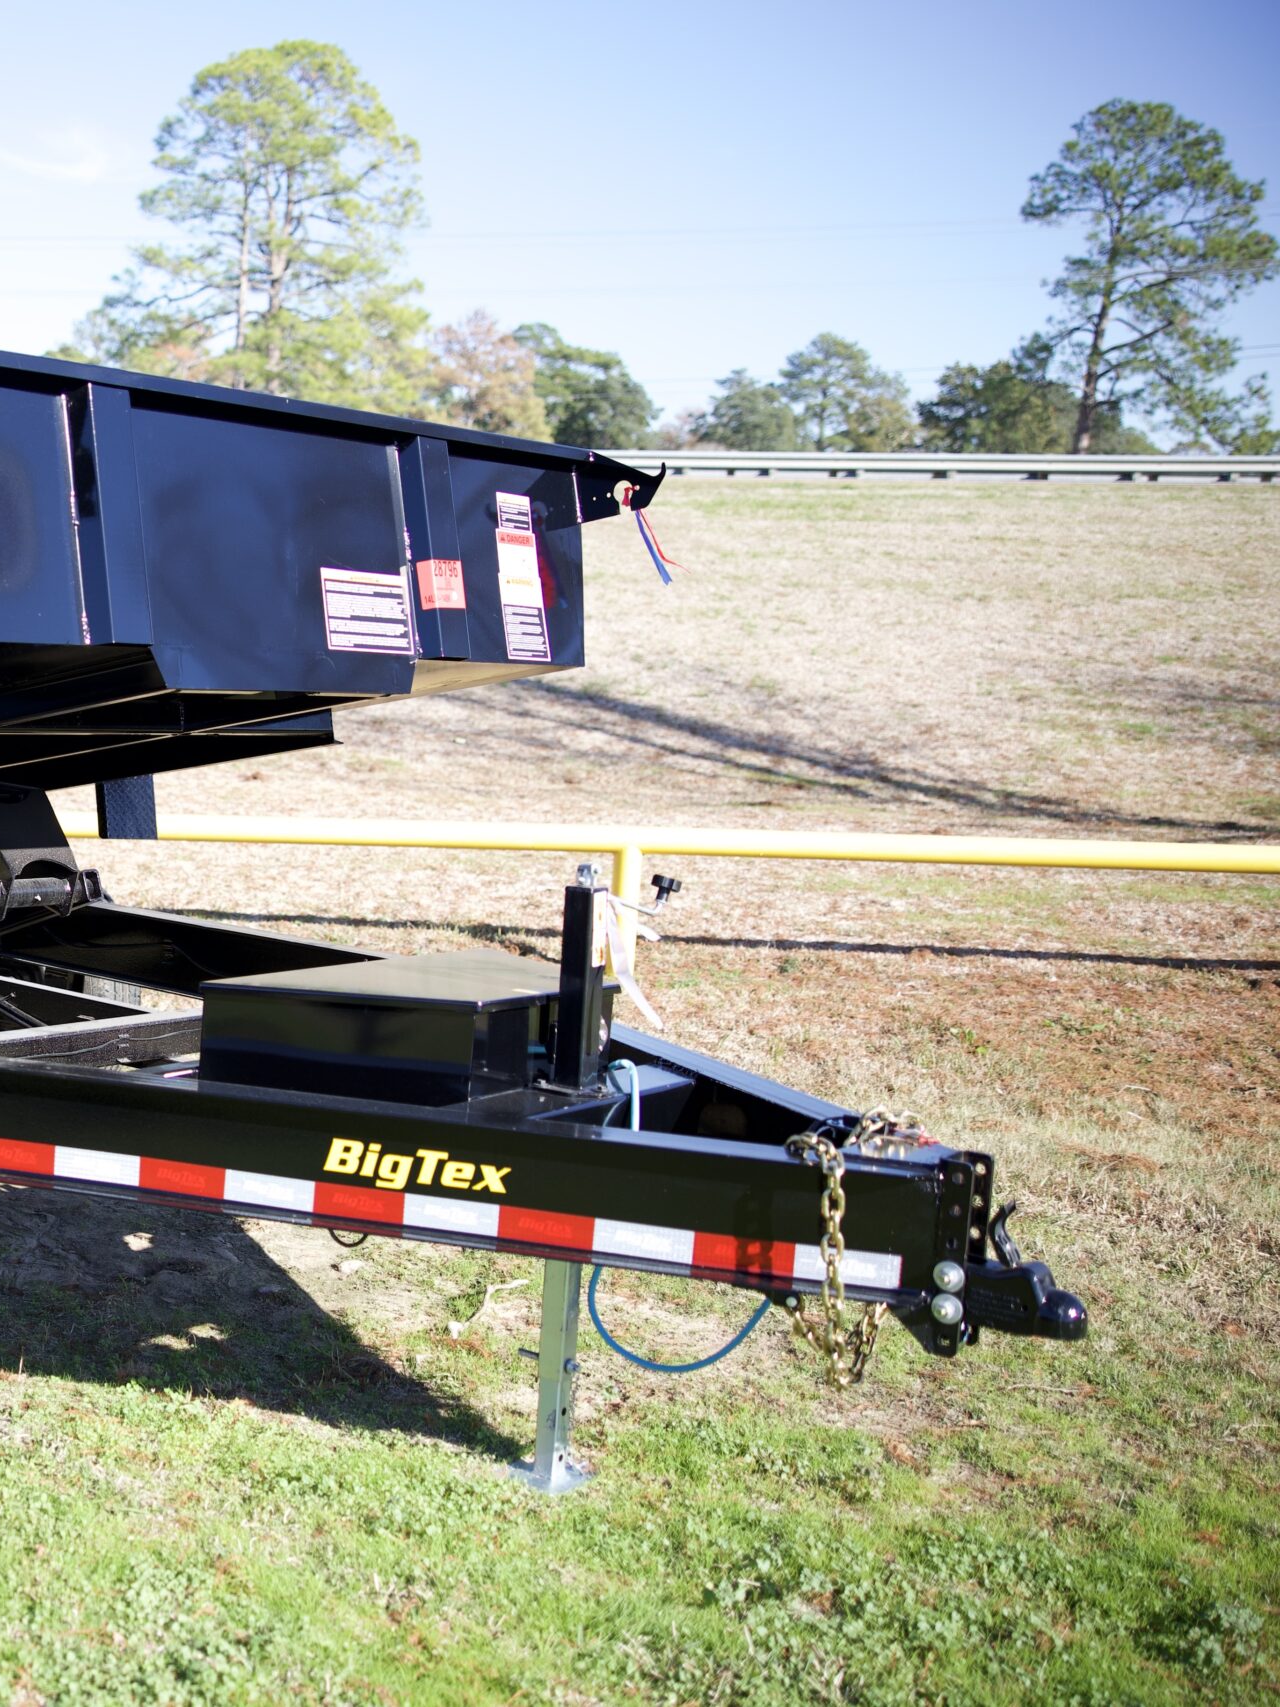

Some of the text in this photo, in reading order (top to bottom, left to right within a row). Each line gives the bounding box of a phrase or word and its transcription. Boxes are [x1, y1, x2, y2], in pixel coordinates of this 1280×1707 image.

[507, 534, 530, 545] DANGER
[433, 560, 458, 578] 28796
[323, 1137, 512, 1194] BigTex
